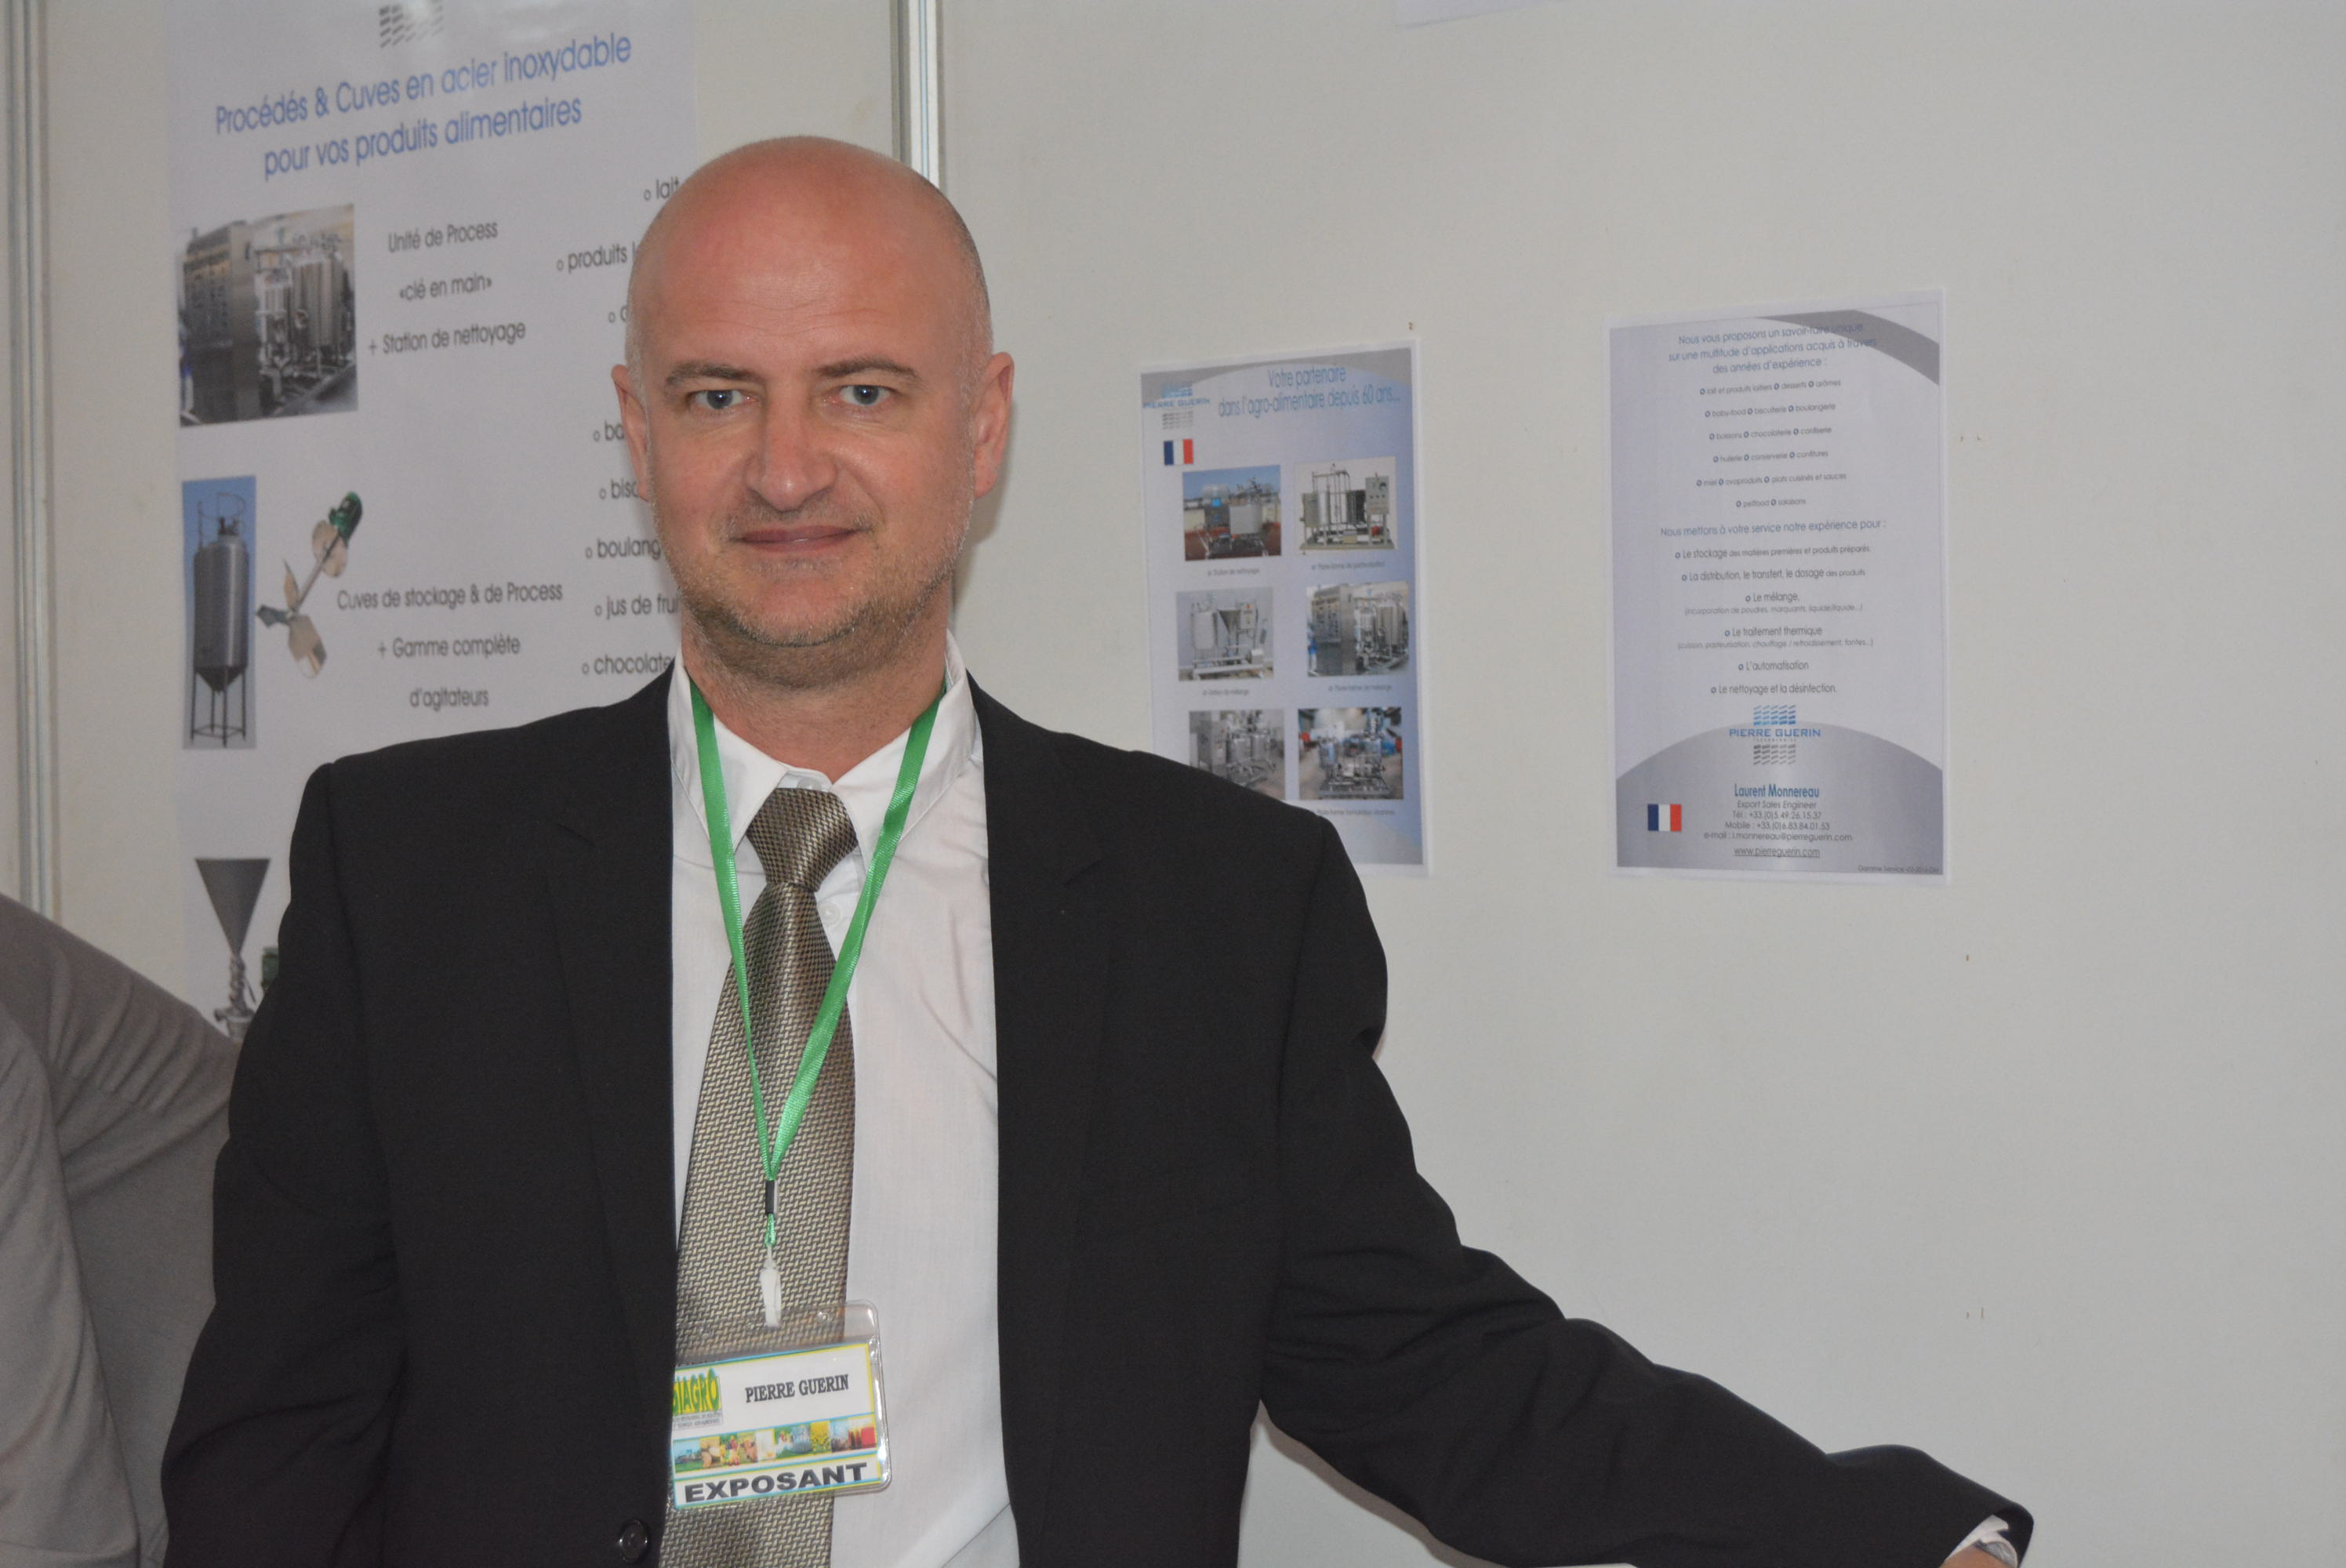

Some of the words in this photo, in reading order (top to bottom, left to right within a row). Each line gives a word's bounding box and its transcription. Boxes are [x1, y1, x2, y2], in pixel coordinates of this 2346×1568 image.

[216, 90, 307, 135] Procédés
[314, 86, 330, 118] &
[336, 82, 400, 112] Cuves
[406, 73, 433, 100] en
[441, 58, 497, 93] acier
[504, 32, 631, 82] inoxydable
[265, 145, 310, 182] pour
[316, 139, 349, 165] vos
[356, 118, 438, 166] produits
[445, 96, 582, 144] alimentaires
[388, 227, 420, 252] Unité
[425, 228, 442, 247] de
[447, 222, 498, 243] Process
[568, 243, 627, 273] produits
[430, 280, 447, 297] en
[383, 332, 427, 354] Station
[431, 328, 449, 348] de
[454, 322, 525, 345] nettoyage
[1679, 335, 1699, 345] Nous
[1701, 333, 1720, 343] vous
[1723, 330, 1767, 343] proposons
[1769, 328, 1780, 338] un
[1781, 325, 1828, 337] savoir-faire
[1669, 352, 1681, 361] sur
[1682, 351, 1698, 361] une
[1700, 347, 1739, 358] multitude
[1742, 343, 1803, 357] d'applications
[1806, 340, 1836, 353] acquis
[1838, 339, 1844, 349] à
[1847, 338, 1877, 348] travers
[1712, 363, 1728, 374] des
[1730, 360, 1761, 372] années
[1763, 358, 1821, 372] d'expérience
[1268, 368, 1294, 389] Votre
[1296, 365, 1346, 386] partenaire
[1218, 398, 1240, 418] dans
[1242, 391, 1324, 419] l'agro-alimentaire
[1328, 389, 1360, 409] depuis
[1363, 386, 1374, 405] 60
[1661, 527, 1682, 537] Nous
[1683, 525, 1717, 536] mettons
[1720, 524, 1726, 534] à
[1727, 524, 1749, 534] votre
[1752, 522, 1781, 533] service
[1783, 521, 1806, 532] notre
[1808, 518, 1858, 533] expérience
[1860, 518, 1881, 530] pour
[1683, 550, 1691, 558] Le
[1693, 548, 1727, 561] stockage
[1689, 572, 1698, 582] La
[1743, 570, 1750, 579] le
[1786, 568, 1792, 578] le
[1795, 568, 1824, 580] dosage
[337, 590, 378, 610] Cuves
[381, 588, 401, 608] de
[405, 587, 466, 609] stockage
[470, 584, 479, 604] &
[485, 584, 503, 603] de
[507, 582, 563, 602] Process
[1753, 593, 1761, 602] Le
[606, 595, 626, 620] jus
[631, 594, 652, 615] de
[1732, 627, 1741, 636] Le
[1743, 626, 1781, 636] traitement
[1784, 625, 1822, 637] thermique
[392, 637, 448, 658] Gamme
[452, 633, 520, 658] complète
[1746, 661, 1809, 670] L'automatisation
[409, 687, 488, 711] d'agitateurs
[1719, 685, 1727, 694] Le
[1729, 684, 1768, 695] nettoyage
[1770, 684, 1778, 692] et
[1780, 684, 1787, 692] la
[1730, 728, 1770, 737] PIERRE
[1775, 728, 1821, 737] GUERIN
[1734, 783, 1766, 797] Laurent
[1768, 784, 1819, 797] Monnereau
[1738, 800, 1760, 810] Export
[1783, 800, 1817, 810] Engineer
[1734, 846, 1820, 858] www.pierreguerin.com
[745, 1381, 795, 1403] PIERRE
[798, 1374, 849, 1396] GUERIN
[685, 1462, 866, 1503] EXPOSANT
